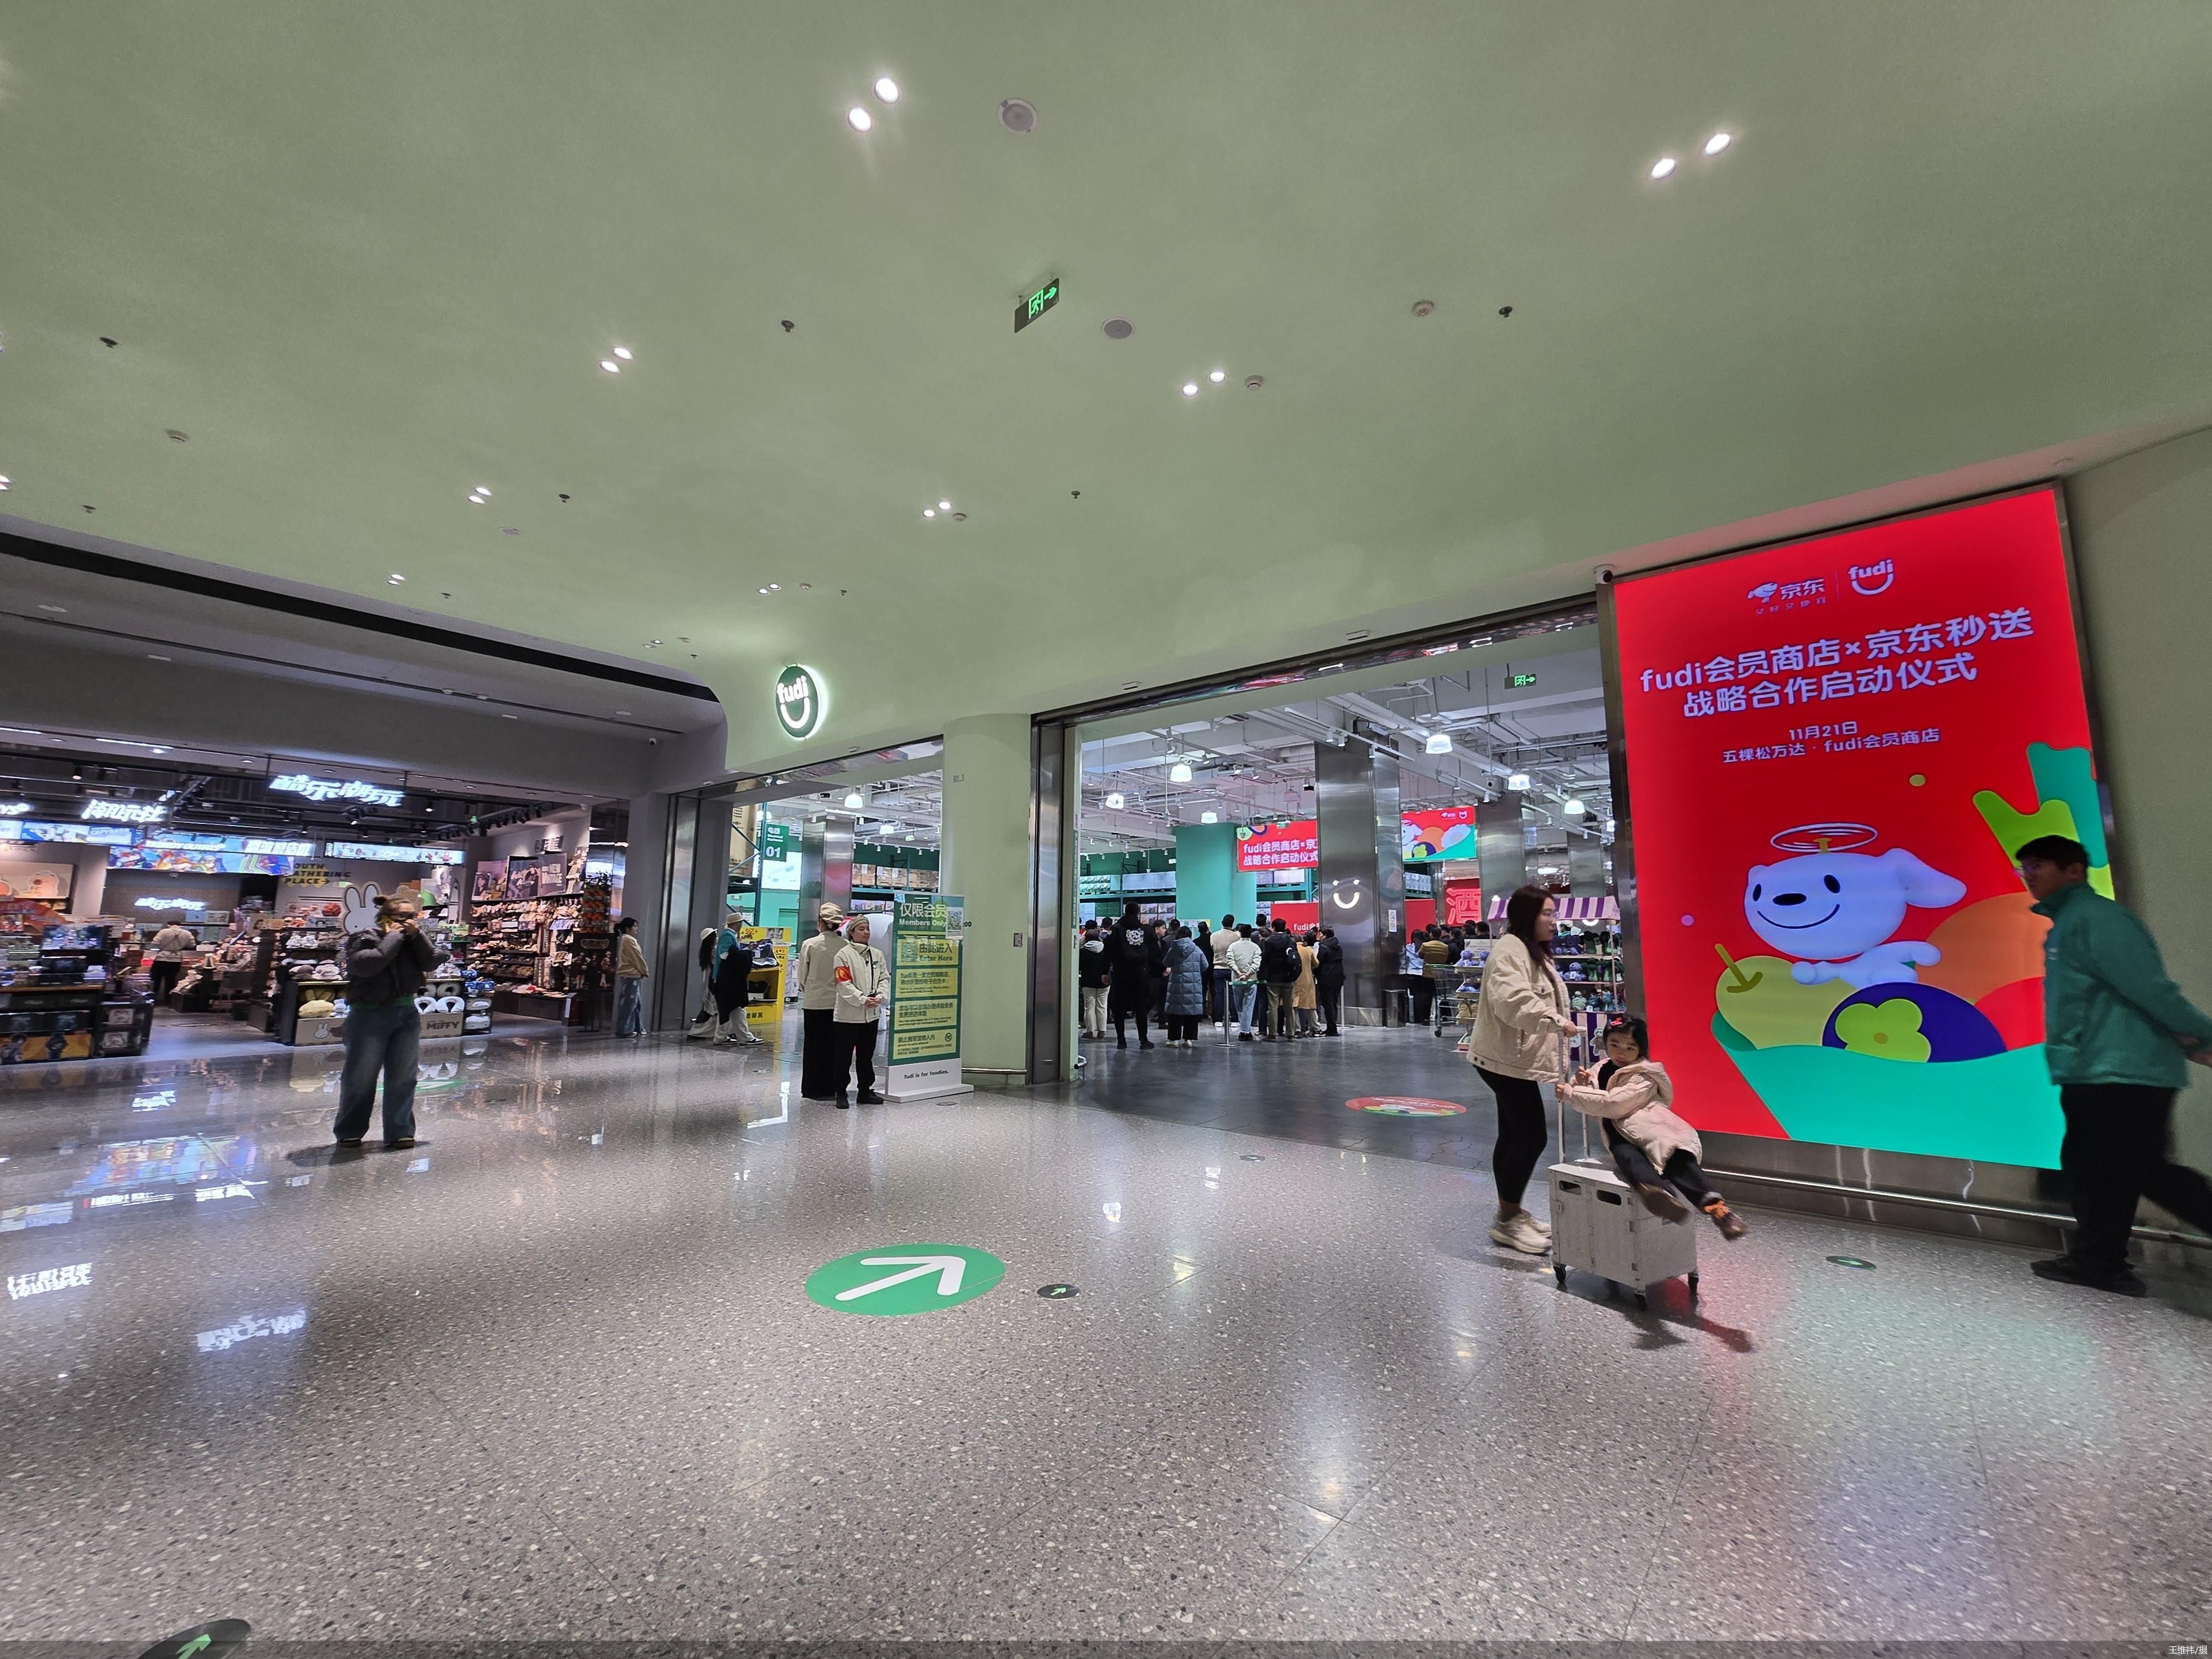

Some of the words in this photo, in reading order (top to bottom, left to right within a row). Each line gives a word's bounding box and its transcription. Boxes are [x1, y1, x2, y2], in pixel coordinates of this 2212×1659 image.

[1848, 559, 1893, 581] fudi
[1780, 578, 1825, 600] 京东
[776, 675, 809, 704] fudi
[1683, 653, 1978, 718] 战略合作启动仪式
[1788, 721, 1858, 741] 11月21日
[1722, 743, 1806, 764] 五棵松万达
[1824, 728, 1940, 753] fudi会员商店
[269, 774, 405, 807] 酷乐潮玩
[766, 846, 781, 858] 01
[1243, 851, 1318, 866] 战略合作启动仪式
[900, 902, 947, 918] 仅限会员
[1446, 888, 1481, 924] 酒
[919, 943, 952, 953] 由此进入
